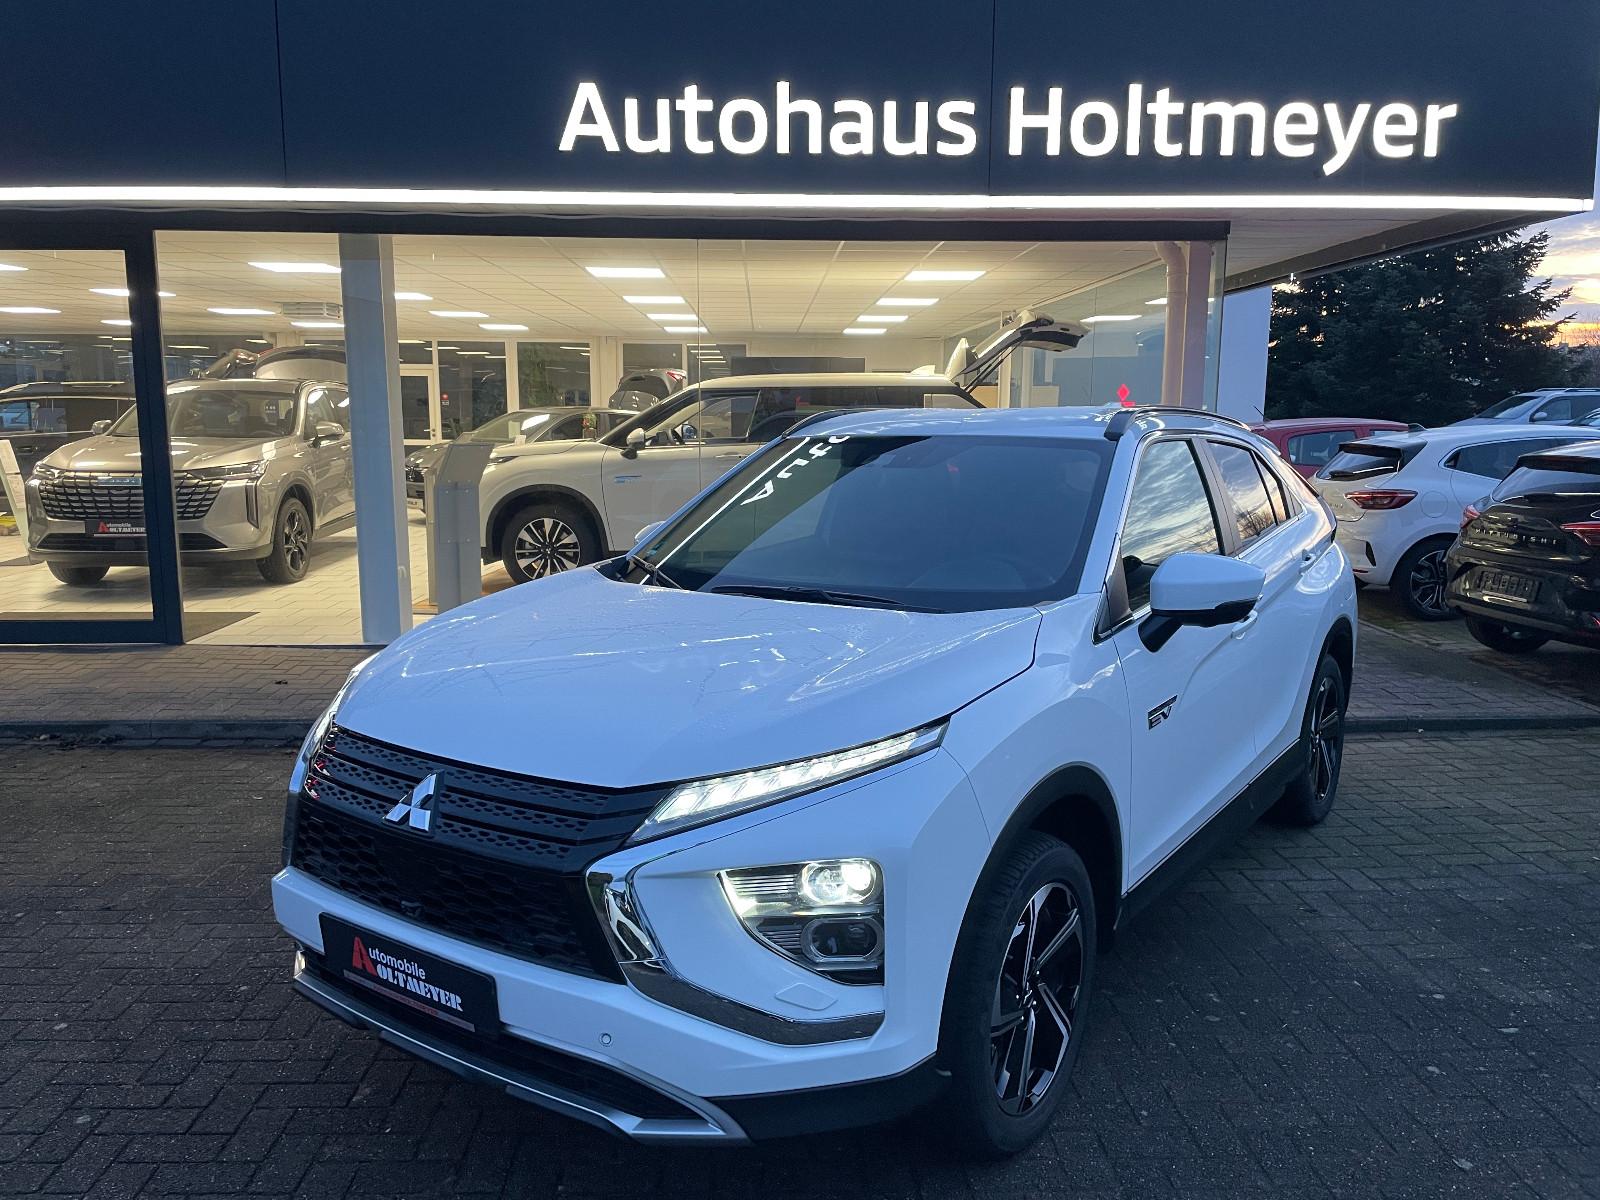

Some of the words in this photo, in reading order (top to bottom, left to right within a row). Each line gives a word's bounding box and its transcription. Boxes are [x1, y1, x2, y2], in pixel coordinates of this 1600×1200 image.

[558, 80, 977, 156] Autohaus
[1008, 83, 1458, 176] Holtmeyer
[351, 935, 426, 980] Automobile
